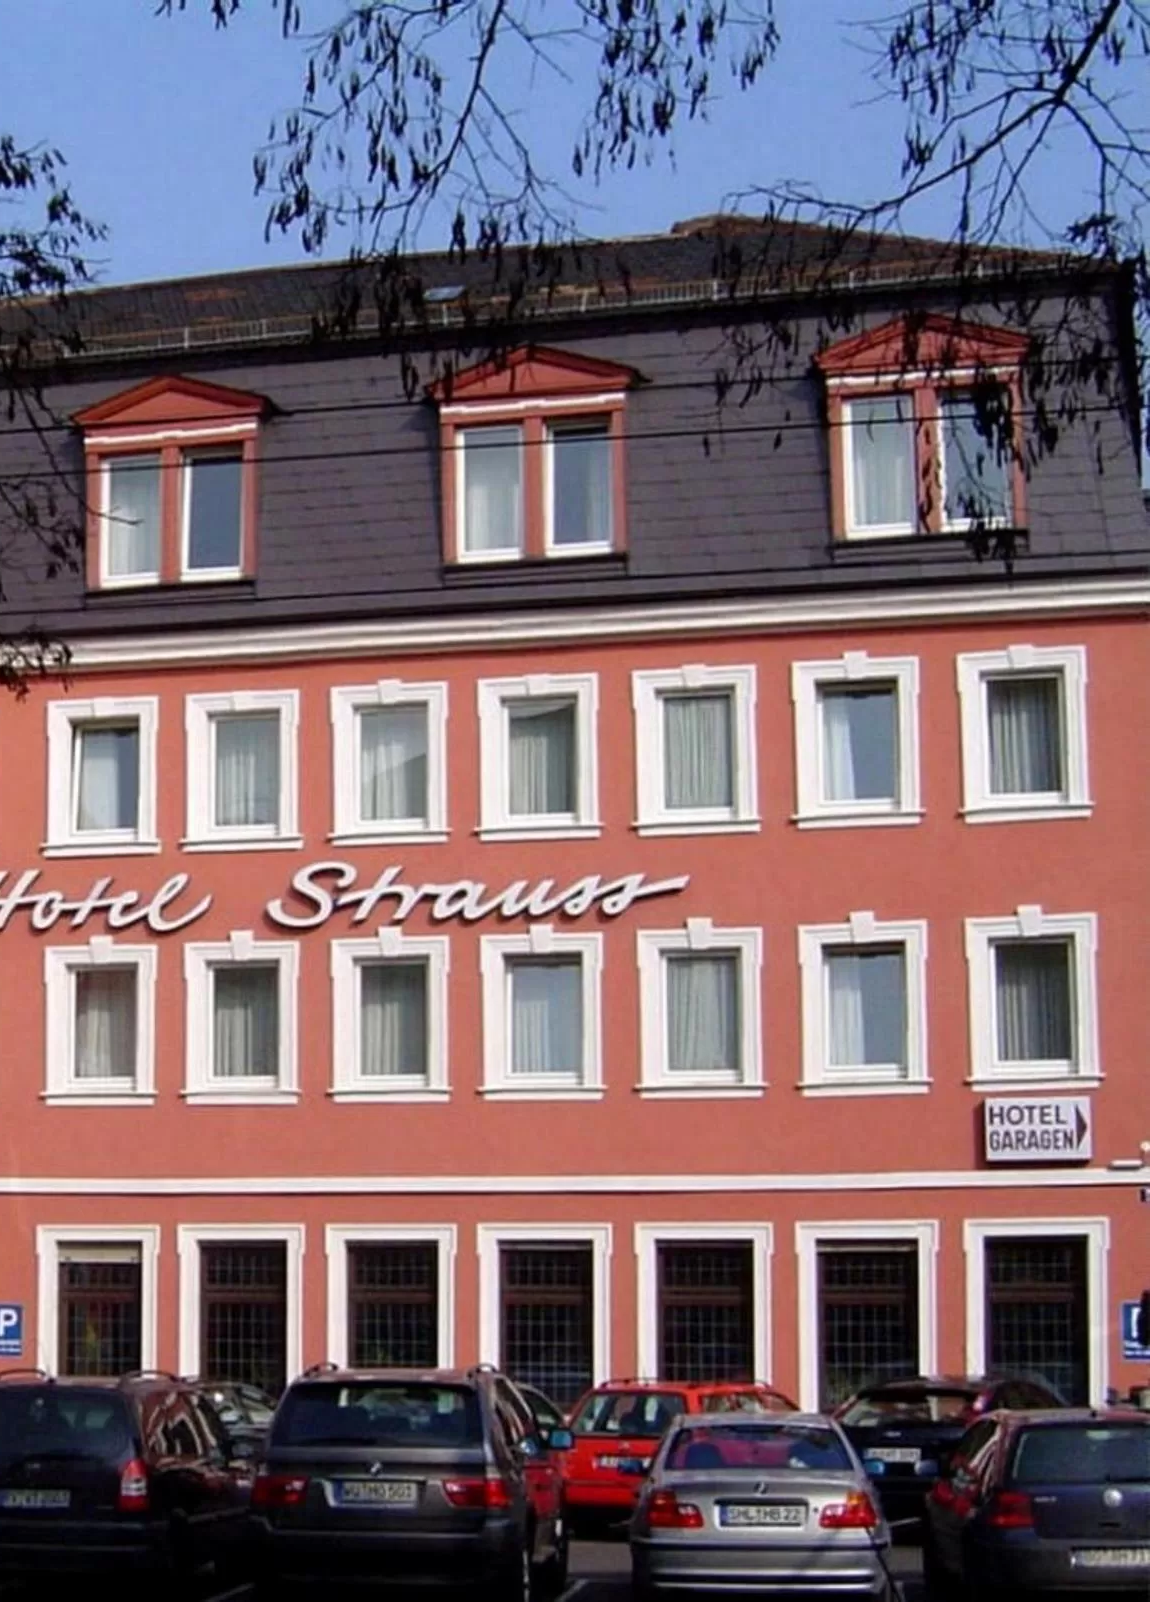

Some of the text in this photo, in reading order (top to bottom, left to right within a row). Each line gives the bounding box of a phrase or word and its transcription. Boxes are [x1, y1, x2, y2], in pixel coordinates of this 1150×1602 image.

[265, 862, 690, 930] Strauss
[989, 1104, 1068, 1126] HOTEL
[989, 1130, 1075, 1152] GARAGEN
[0, 1308, 18, 1337] P
